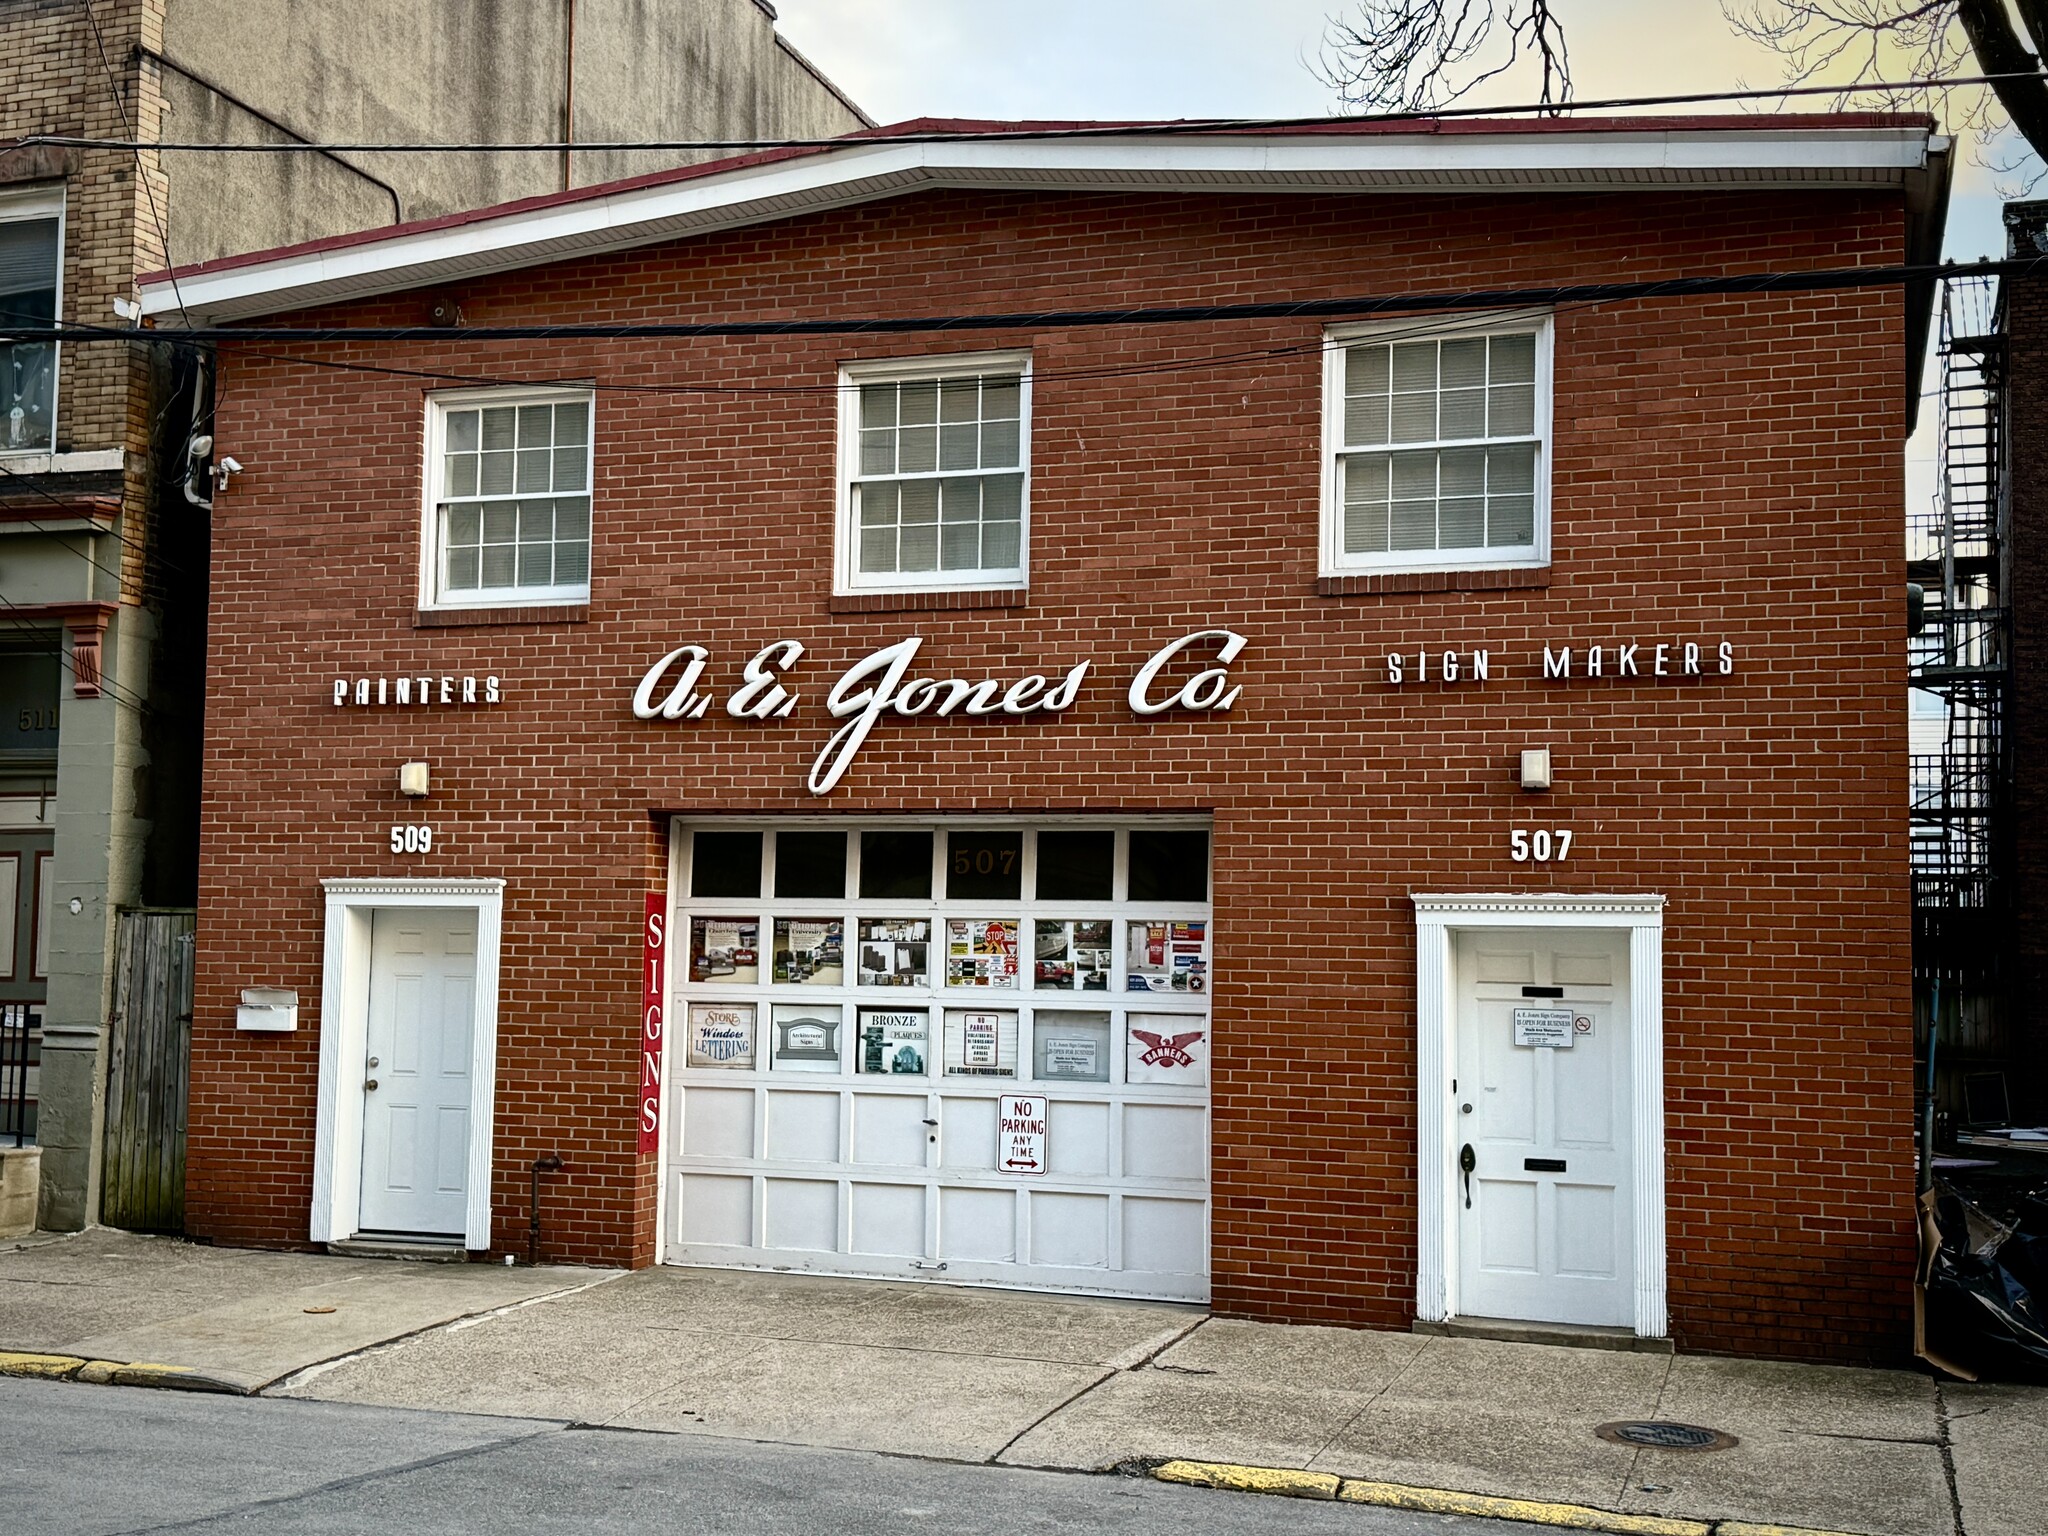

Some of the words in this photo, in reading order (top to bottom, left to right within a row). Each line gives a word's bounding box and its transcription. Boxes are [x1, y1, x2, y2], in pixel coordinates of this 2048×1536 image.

[1387, 650, 1489, 684] SIGN
[1542, 641, 1733, 678] MAKERS
[333, 675, 500, 706] PAINTERS
[19, 708, 58, 730] 511
[807, 637, 1091, 796] Jones
[1127, 629, 1249, 715] Co.
[390, 825, 433, 854] 509
[1511, 829, 1573, 862] 507
[954, 848, 1017, 875] 507
[986, 930, 1004, 941] STOP
[641, 912, 664, 1133] SIGNS
[871, 1014, 917, 1027] BRONZE
[700, 1027, 744, 1038] Window
[893, 1031, 923, 1039] PLAQUES
[695, 1039, 749, 1061] LETTERING
[1144, 1047, 1188, 1064] BANNERS
[948, 1066, 957, 1074] ALL
[957, 1066, 971, 1075] KINDS
[971, 1067, 978, 1075] OF
[978, 1067, 999, 1076] PARKING
[999, 1068, 1014, 1076] SIGNS
[1014, 1101, 1033, 1117] NO
[1001, 1118, 1044, 1135] PARKING
[1012, 1135, 1032, 1146] ANY
[1011, 1146, 1034, 1158] TIME
